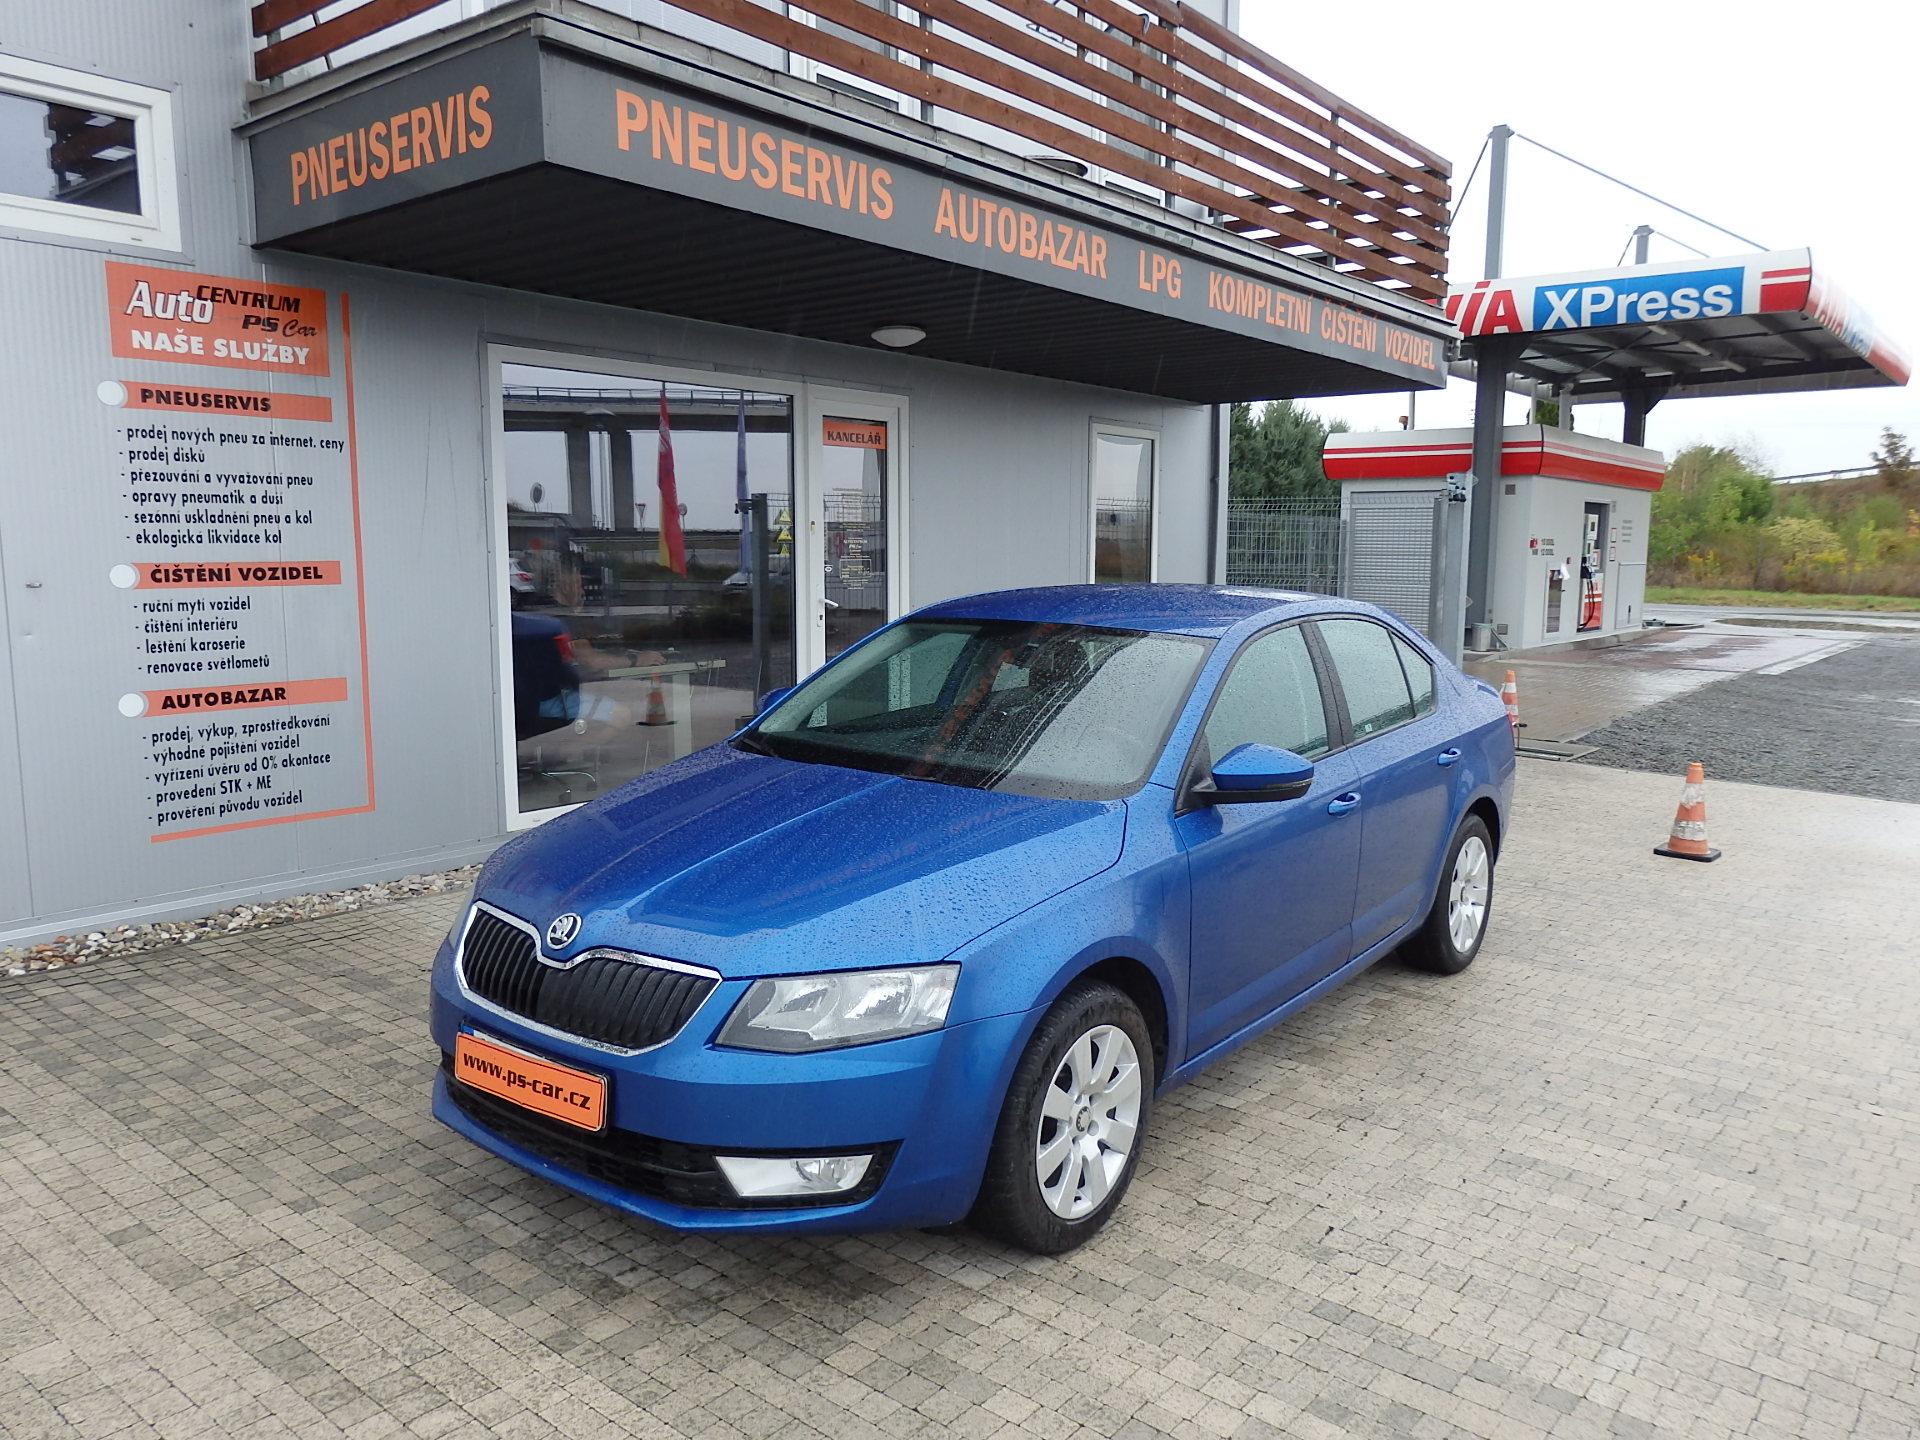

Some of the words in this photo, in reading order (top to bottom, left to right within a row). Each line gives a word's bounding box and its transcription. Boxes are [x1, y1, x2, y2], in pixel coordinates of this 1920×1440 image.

[290, 85, 493, 205] PNEUSERVIS
[616, 88, 894, 220] PNEUSERVIS
[934, 188, 1107, 279] AUTOBAZAR
[1139, 249, 1182, 299] LPG
[1209, 271, 1313, 334] KOMPLETNÍ
[1320, 297, 1379, 352] ČIŠTĚNÍ
[1385, 327, 1436, 370] VOZIDEL
[125, 279, 214, 324] Auto
[196, 284, 301, 313] CENTRUM
[1542, 282, 1733, 331] XPress
[242, 314, 280, 333] PS
[282, 319, 317, 337] Car
[131, 328, 204, 356] NAŠE
[213, 338, 310, 365] SLUŽBY
[140, 388, 272, 412] PNEUSERVIS
[127, 424, 167, 443] prodej
[171, 427, 215, 446] nových
[220, 433, 248, 446] pneu
[252, 434, 266, 445] za
[270, 431, 317, 448] internet.
[320, 438, 344, 453] ceny
[827, 429, 882, 446] KANCELÁŘ
[129, 446, 169, 465] prodej
[130, 468, 200, 485] přezouvání
[204, 473, 211, 483] a
[216, 472, 283, 488] vyvažování
[287, 476, 313, 489] pneu
[132, 492, 177, 507] opravy
[182, 489, 245, 507] pneumatik
[250, 494, 257, 504] a
[134, 509, 181, 524] sezónní
[185, 508, 250, 524] uskladnění
[253, 513, 281, 528] pneu
[284, 514, 291, 524] a
[295, 510, 313, 524] kol
[136, 528, 203, 548] ekologická
[207, 528, 261, 544] likvidace
[264, 528, 282, 544] kol
[150, 564, 232, 583] ČIŠTĚNÍ
[238, 566, 323, 582] VOZIDEL
[143, 599, 173, 613] ruční
[177, 598, 205, 616] mytí
[209, 595, 251, 610] vozidel
[144, 618, 183, 633] čištění
[187, 616, 238, 632] interiéru
[145, 638, 186, 654] leštění
[190, 635, 246, 652] karoserie
[147, 661, 203, 674] renovace
[207, 654, 270, 671] světlometů
[161, 687, 287, 710] AUTOBAZAR
[152, 725, 194, 747] prodej,
[198, 722, 238, 742] výkup,
[242, 713, 330, 738] zprostředkování
[153, 744, 206, 767] výhodné
[210, 739, 257, 761] pojištění
[261, 734, 300, 752] vozidel
[155, 765, 204, 787] vyřízení
[207, 763, 240, 777] úvěru
[244, 757, 258, 773] od
[261, 755, 278, 770] 0%
[281, 753, 331, 769] akontace
[156, 782, 216, 807] provedení
[220, 778, 242, 795] STK
[246, 781, 252, 789] +
[257, 775, 272, 790] ME
[157, 802, 216, 827] prověření
[219, 796, 260, 818] původu
[264, 789, 303, 808] vozidel
[463, 1052, 591, 1111] www.ps-car.cz
